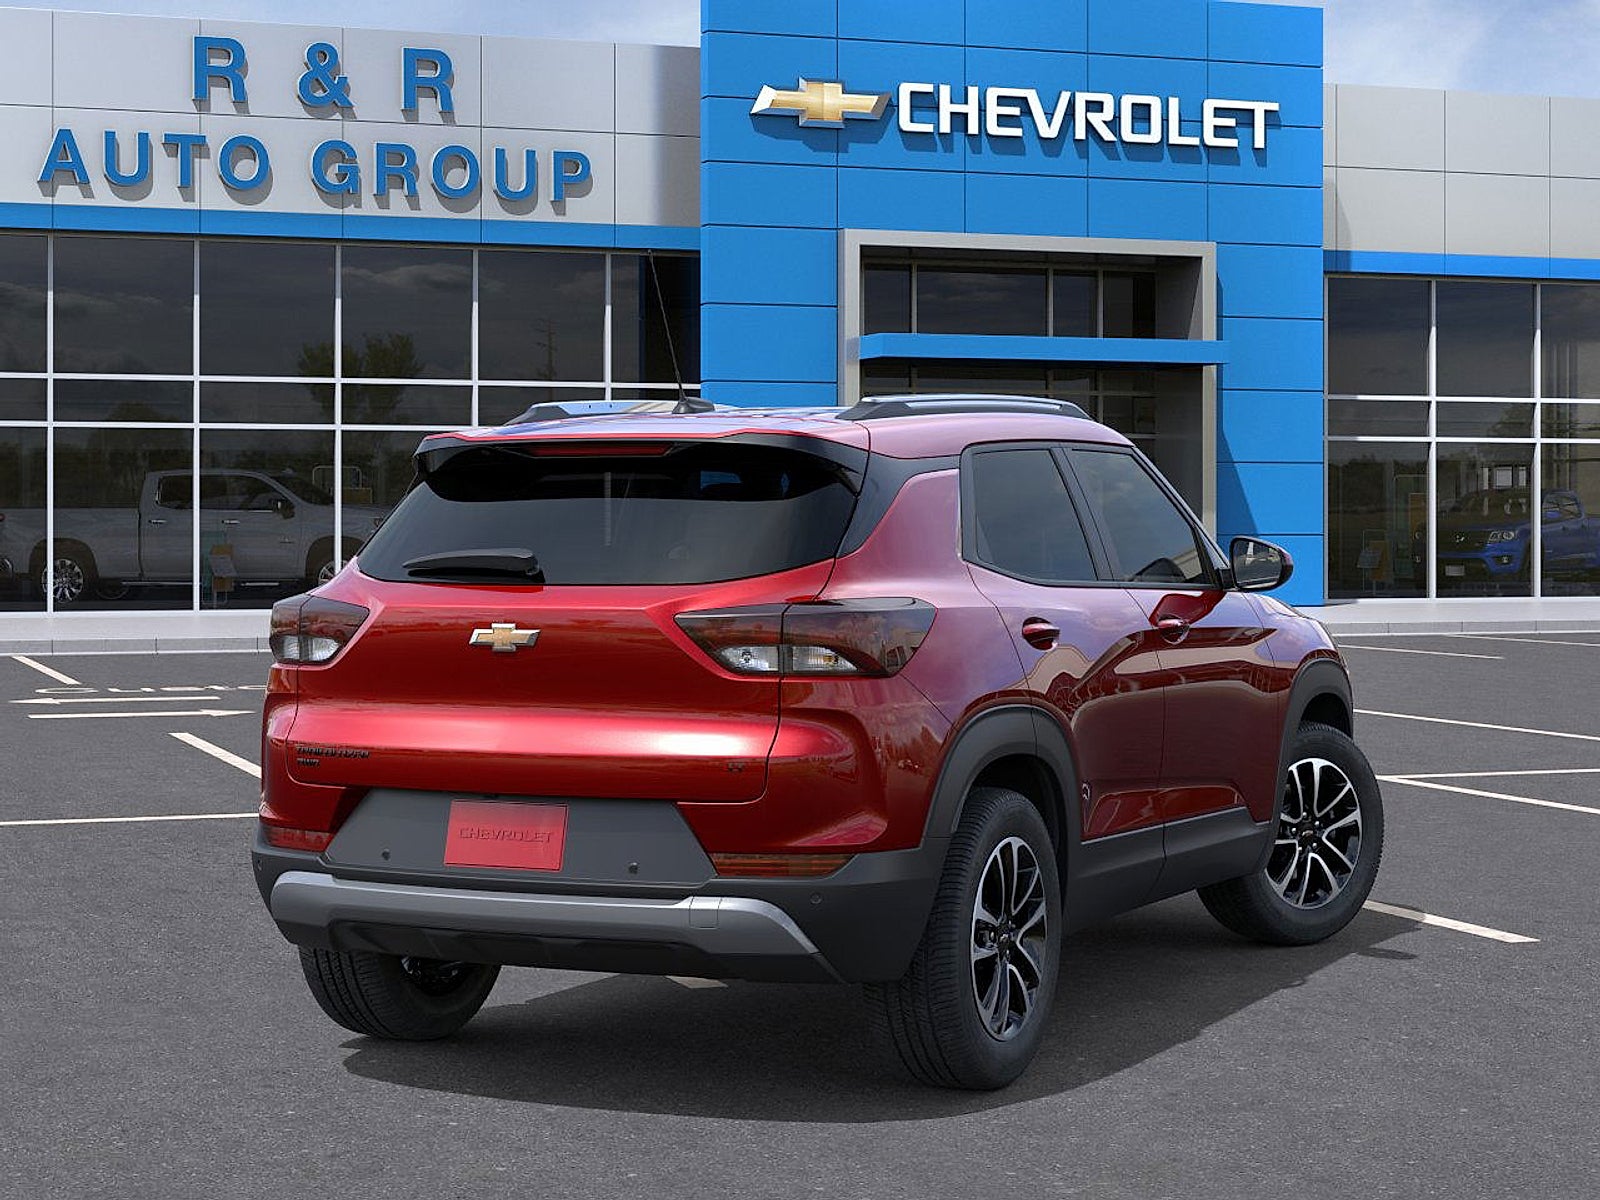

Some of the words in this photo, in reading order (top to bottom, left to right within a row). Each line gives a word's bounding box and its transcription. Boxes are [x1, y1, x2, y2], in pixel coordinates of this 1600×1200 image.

[192, 36, 247, 102] R
[298, 42, 354, 108] &
[402, 47, 454, 112] R
[898, 82, 1279, 149] CHEVROLET
[38, 128, 271, 190] AUTO
[312, 139, 592, 202] GROUP
[459, 827, 551, 843] CHEVROLET
